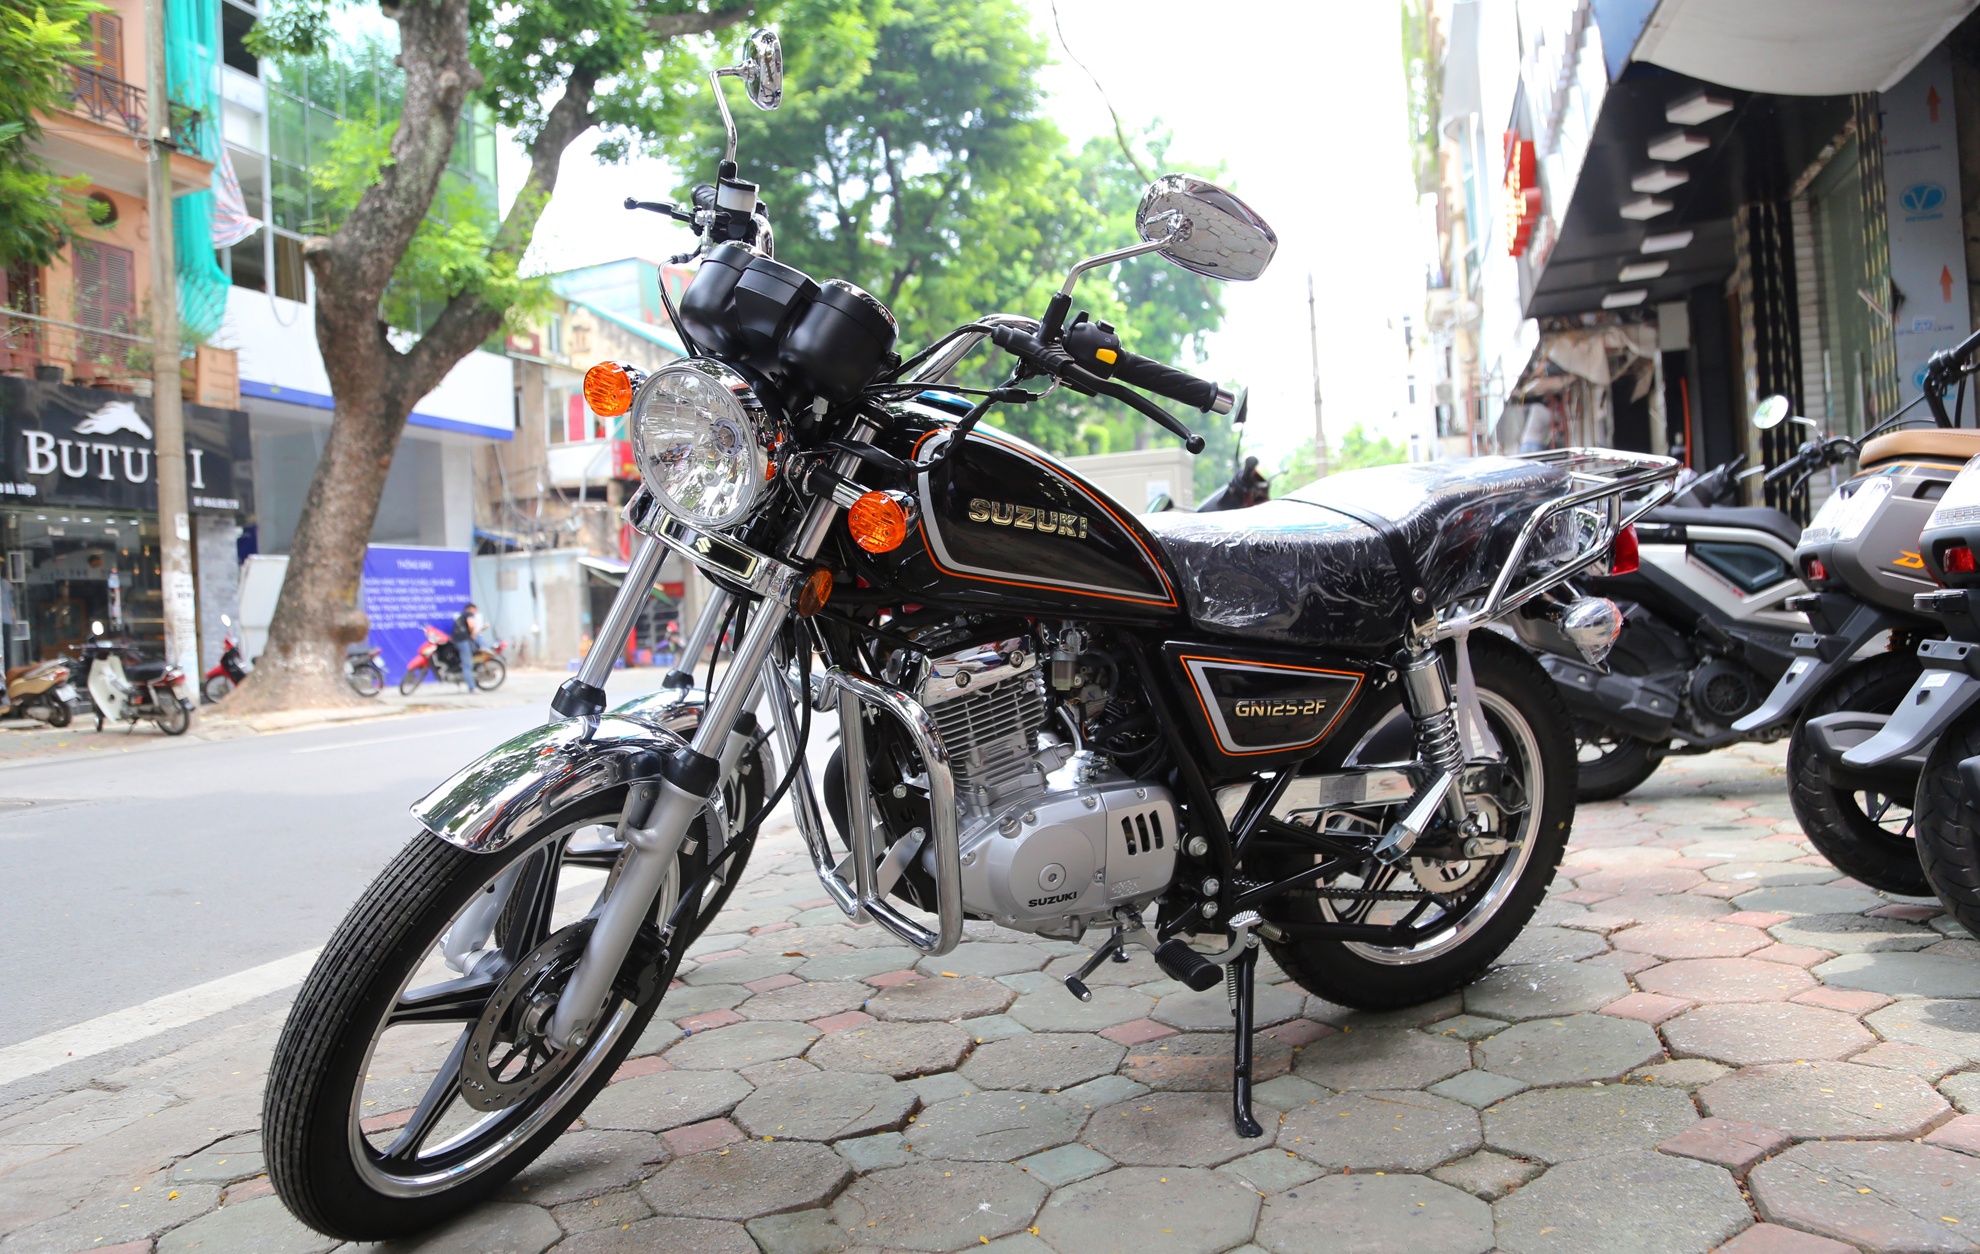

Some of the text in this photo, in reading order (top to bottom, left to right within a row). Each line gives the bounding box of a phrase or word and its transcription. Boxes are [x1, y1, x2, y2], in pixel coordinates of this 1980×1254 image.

[21, 429, 205, 489] BUTUI
[968, 498, 1088, 538] SUZUKI
[1235, 699, 1327, 717] GN125-2F
[1028, 891, 1078, 908] SUZUKI
